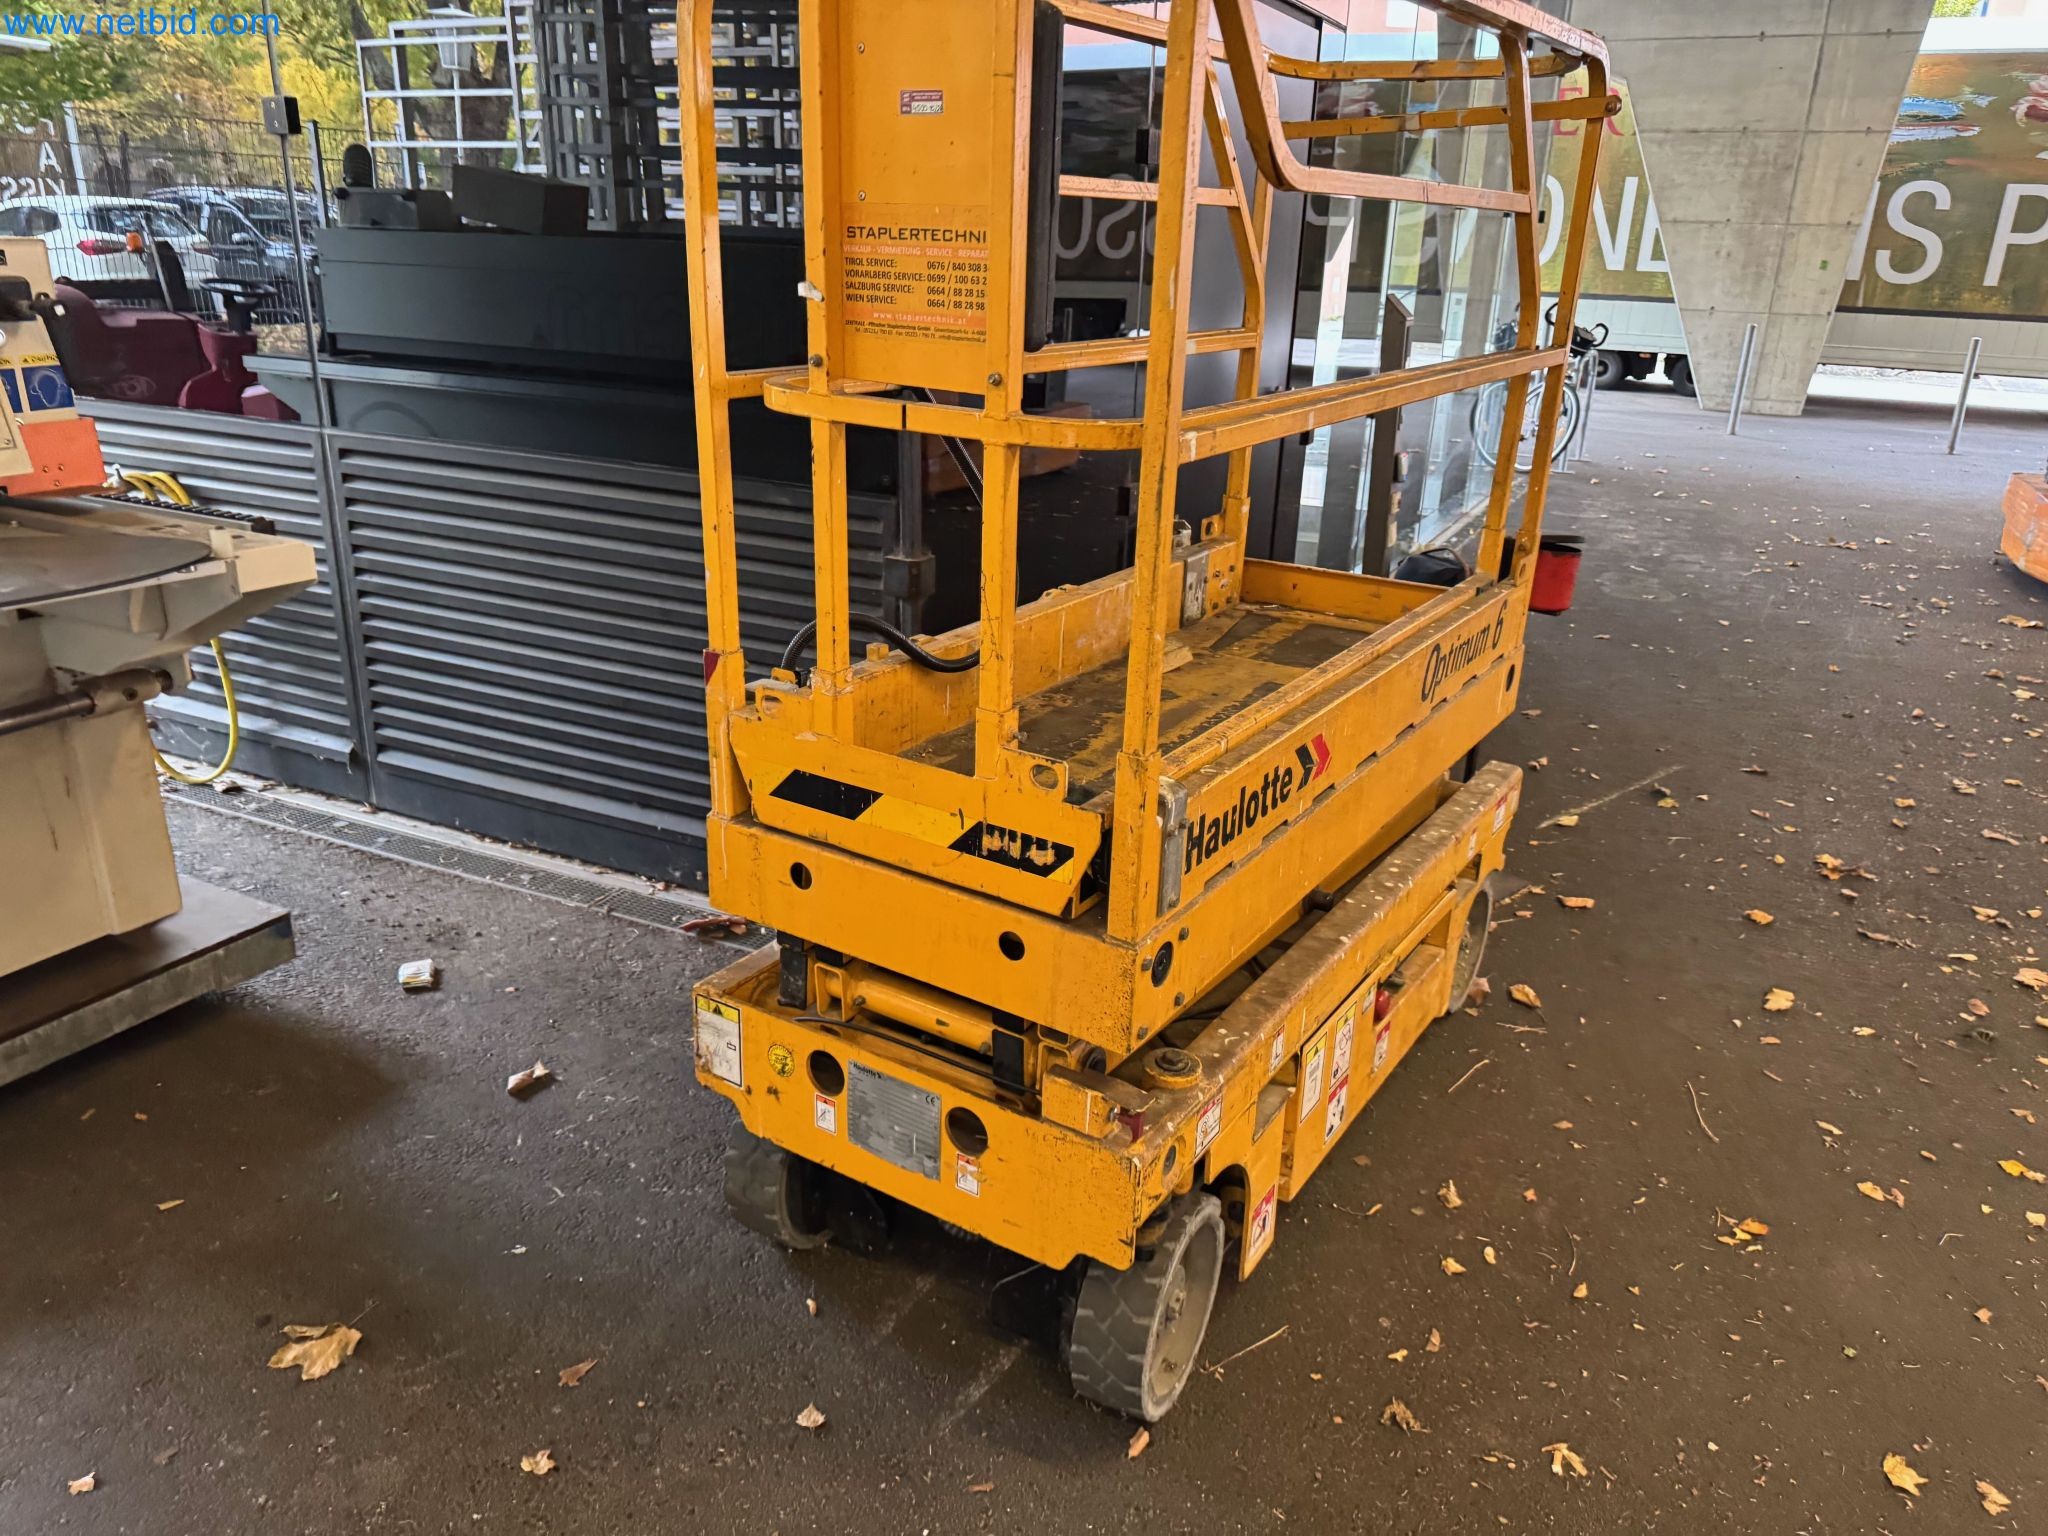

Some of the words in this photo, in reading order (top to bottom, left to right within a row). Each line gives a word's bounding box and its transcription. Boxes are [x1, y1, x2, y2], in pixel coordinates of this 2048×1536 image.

[847, 226, 987, 244] STAPLERTECHNI
[925, 247, 953, 257] SERVICE
[845, 257, 864, 266] TIROL
[866, 258, 897, 268] SERVICE:
[927, 261, 945, 270] 0676
[952, 262, 966, 271] 840
[967, 262, 981, 272] 308
[845, 269, 892, 280] VORARLBERG
[893, 271, 926, 282] SERVICE:
[927, 273, 946, 283] 0699
[954, 275, 969, 284] 100
[970, 276, 980, 285] 63
[845, 281, 881, 292] SALZBURG
[882, 283, 914, 294] SERVICE:
[927, 286, 945, 295] 0664
[953, 287, 963, 297] 88
[964, 288, 974, 297] 28
[976, 289, 985, 298] 15
[846, 293, 864, 303] WIEN
[866, 294, 897, 305] SERVICE:
[927, 298, 945, 308] 0664
[953, 300, 963, 309] 88
[964, 301, 974, 310] 28
[1421, 624, 1491, 704] Optimum
[1492, 599, 1508, 650] 6
[1184, 766, 1295, 874] Haulotte
